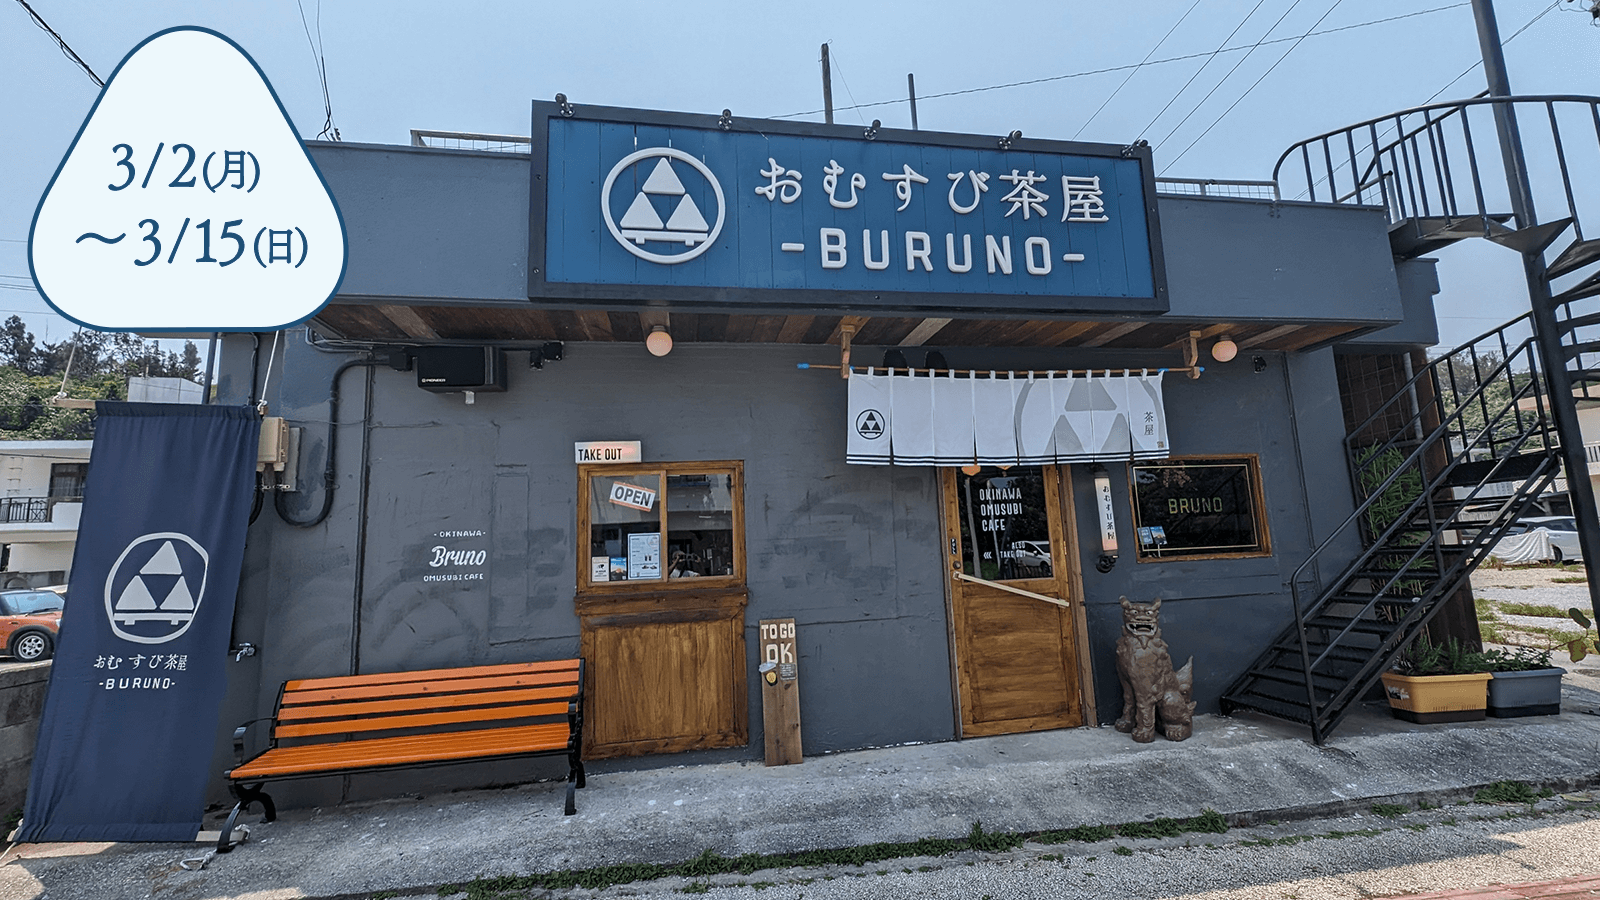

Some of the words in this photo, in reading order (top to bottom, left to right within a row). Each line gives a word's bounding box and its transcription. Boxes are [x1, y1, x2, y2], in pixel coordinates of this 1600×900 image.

[754, 156, 1109, 224] おむすび茶屋
[1143, 411, 1154, 436] 茶屋
[578, 448, 602, 461] TAKE
[604, 448, 622, 461] OUT
[614, 486, 651, 507] OPEN
[979, 487, 1022, 501] OKINAWA
[980, 502, 1023, 516] OMUSUBI
[1168, 497, 1223, 514] BRUNO
[981, 519, 1006, 532] CAFE
[429, 545, 487, 568] Bruno
[1000, 550, 1014, 559] TAKE
[423, 574, 462, 582] OMUSUBI
[761, 624, 778, 640] TO
[780, 623, 796, 639] GO
[93, 653, 188, 671] おむすび茶屋
[766, 643, 793, 664] OK
